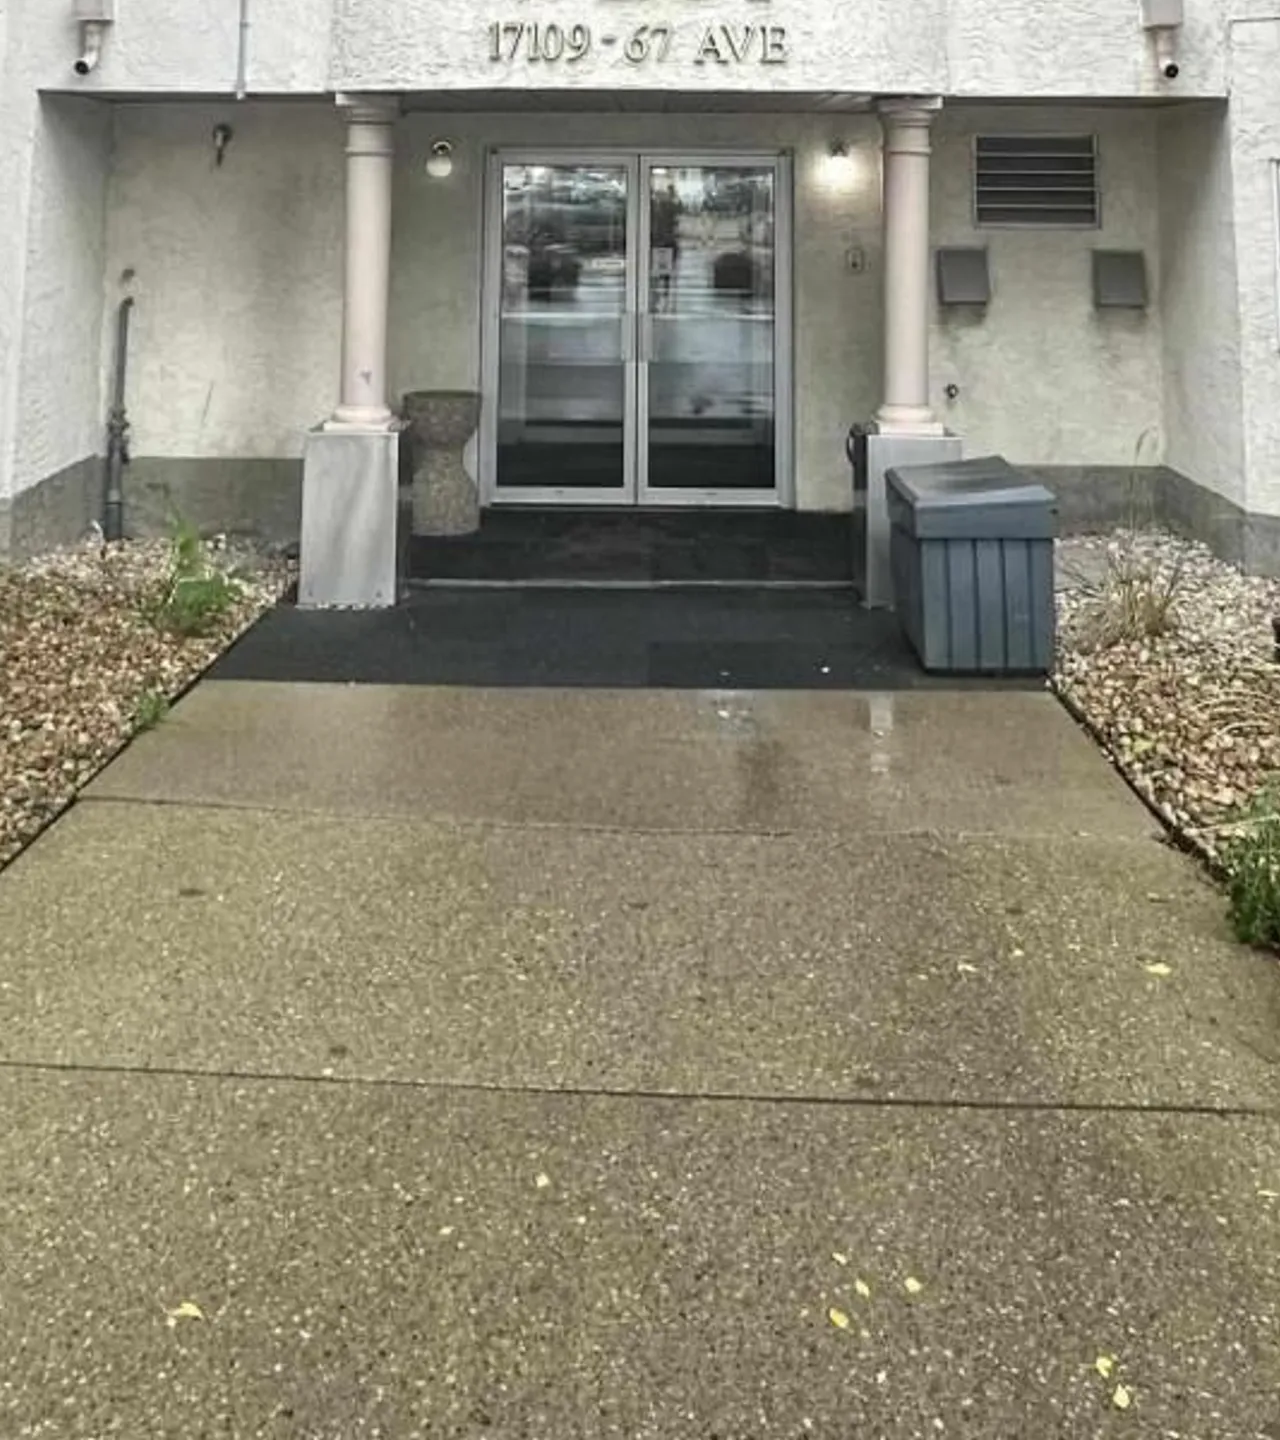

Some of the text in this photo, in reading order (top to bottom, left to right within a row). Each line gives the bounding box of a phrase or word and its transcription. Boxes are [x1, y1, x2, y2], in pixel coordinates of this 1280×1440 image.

[488, 22, 591, 62] 17109
[624, 25, 672, 64] 67
[693, 25, 789, 65] AVE
